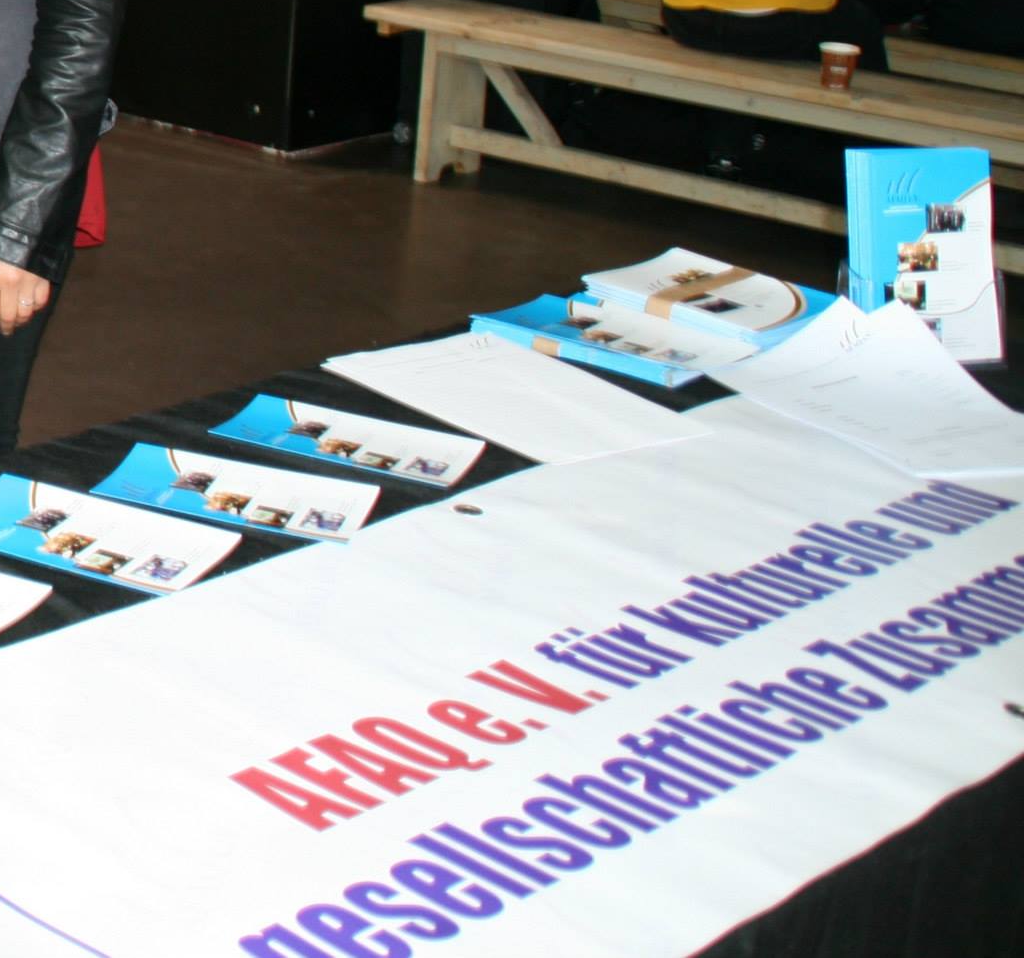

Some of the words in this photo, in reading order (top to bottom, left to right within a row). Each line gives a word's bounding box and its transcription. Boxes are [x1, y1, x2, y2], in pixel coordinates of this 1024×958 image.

[227, 715, 493, 832] AFAQ
[534, 625, 694, 689] für
[619, 519, 934, 647] kulturelle
[874, 478, 1020, 536] und
[801, 554, 1024, 692] Zusamm
